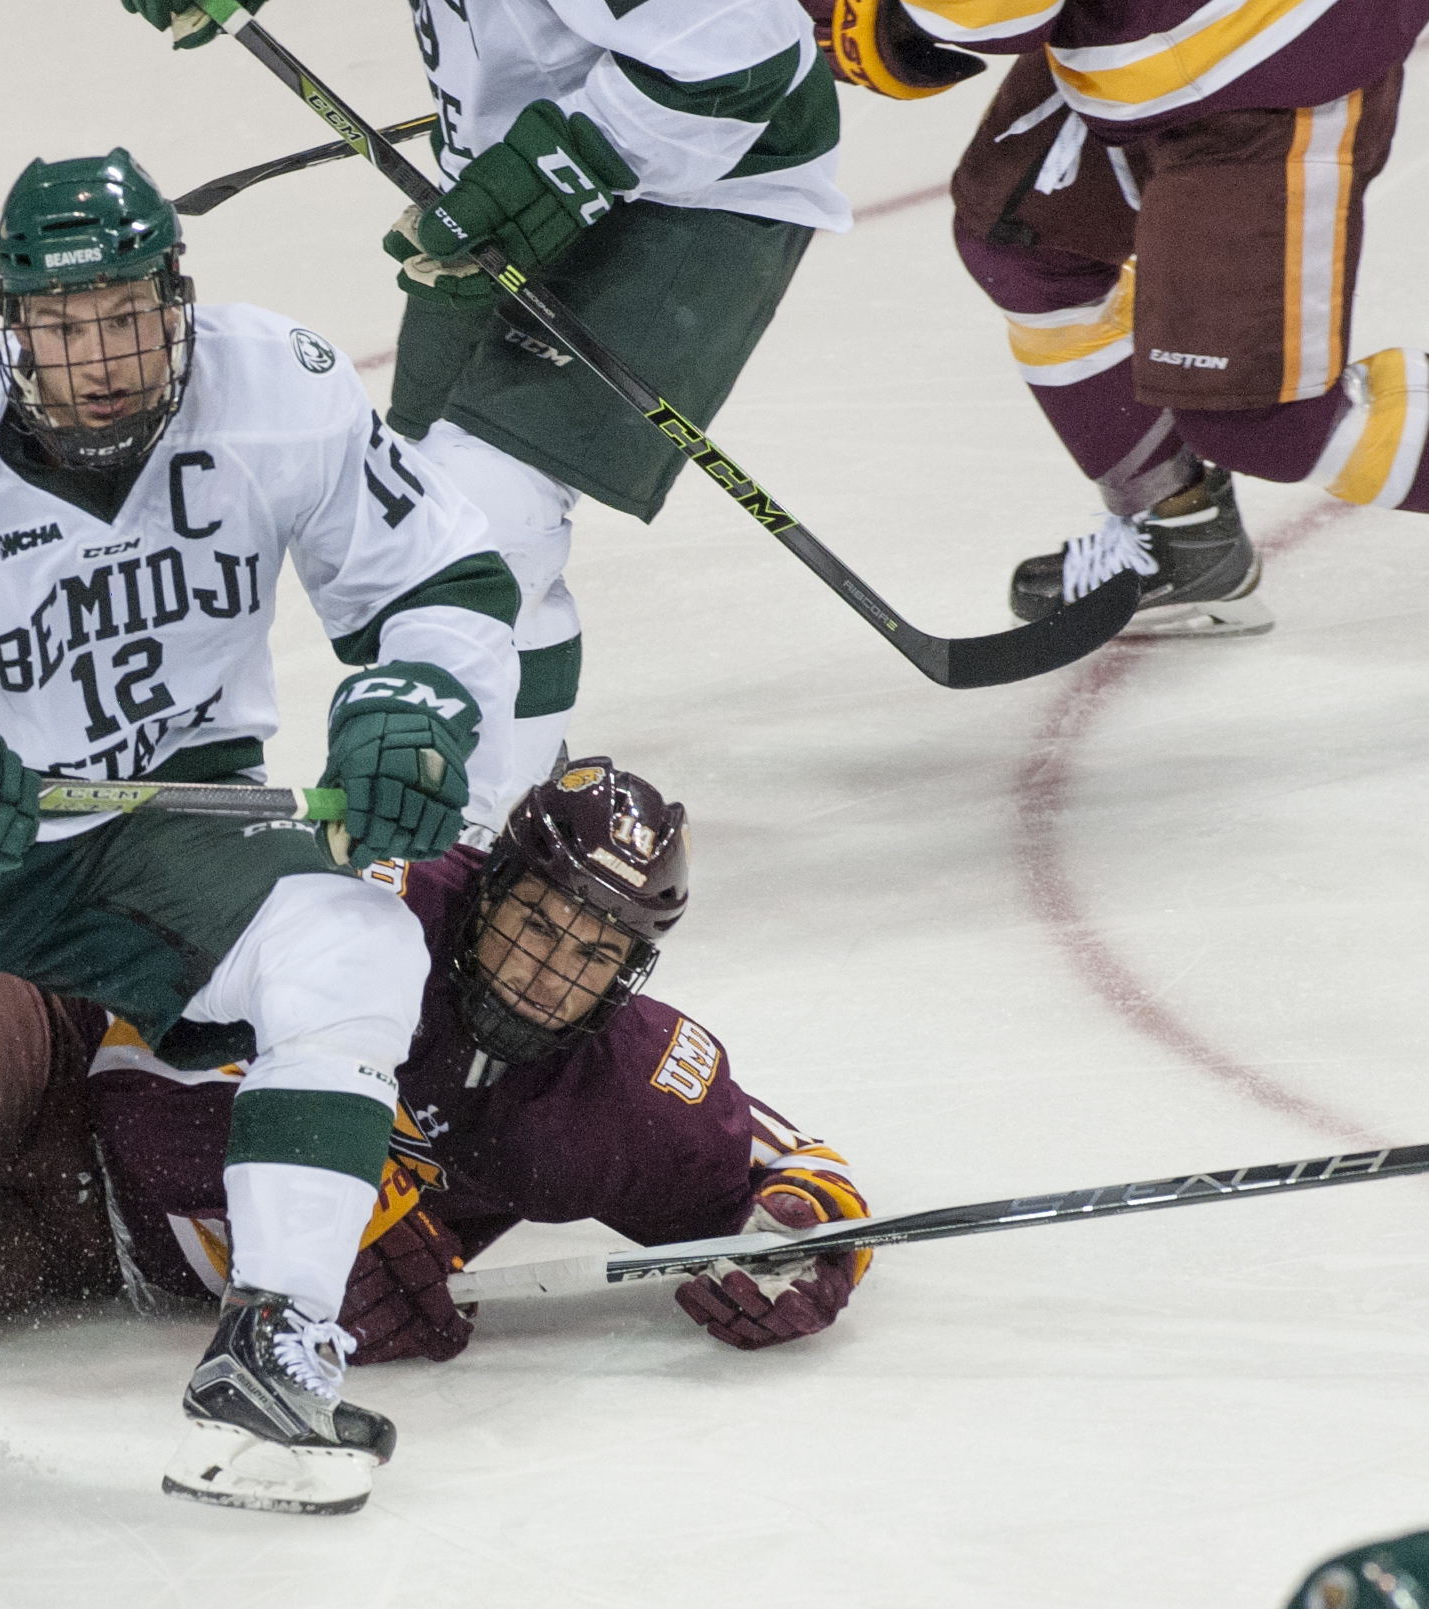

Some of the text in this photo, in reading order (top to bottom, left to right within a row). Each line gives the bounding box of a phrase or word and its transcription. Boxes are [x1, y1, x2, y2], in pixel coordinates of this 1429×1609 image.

[307, 91, 363, 142] CCM
[537, 146, 612, 226] CC
[434, 207, 469, 240] CCM
[44, 247, 103, 269] BEAVERS
[505, 327, 574, 367] CCM
[1149, 348, 1230, 370] EASTON
[79, 436, 134, 456] CCM
[644, 397, 799, 536] CCM
[170, 450, 223, 540] C
[82, 537, 141, 559] CCM
[71, 636, 176, 743] 12
[64, 787, 141, 800] CCM
[614, 814, 656, 858] 14
[357, 1065, 397, 1091] CCM
[649, 1017, 721, 1105] UMD
[1000, 1149, 1391, 1221] STEALTH
